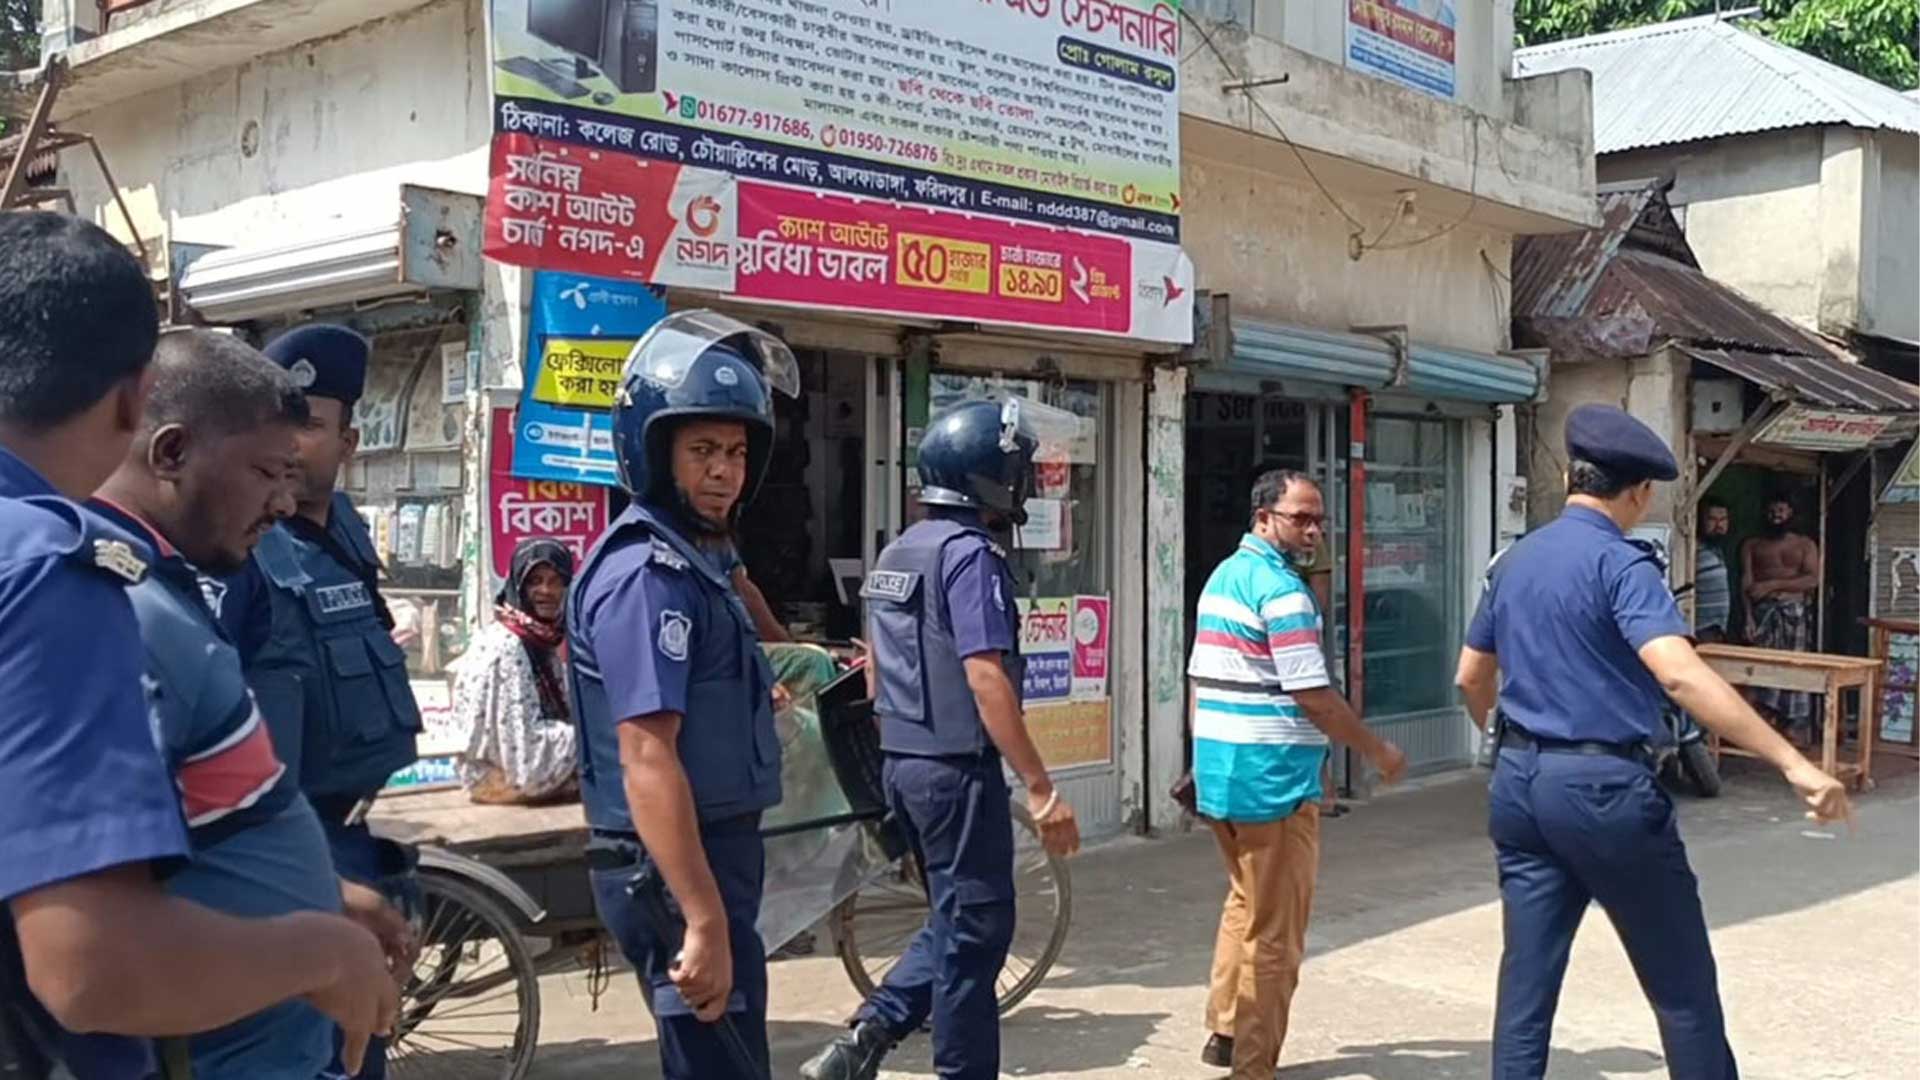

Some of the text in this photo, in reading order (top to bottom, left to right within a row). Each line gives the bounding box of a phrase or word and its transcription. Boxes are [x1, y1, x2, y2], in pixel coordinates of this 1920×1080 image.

[672, 8, 699, 26] করা
[705, 16, 725, 32] হয়
[1060, 0, 1175, 56] স্টেশনারি
[697, 98, 813, 141] 01677-917686,
[839, 126, 938, 165] 01950-726876
[576, 117, 635, 149] কলেজ
[641, 129, 684, 160] রোড,
[783, 155, 822, 183] মোড়,
[914, 172, 967, 205] ফরিদপুর
[981, 189, 1033, 212] E-mail:
[565, 194, 636, 227] আউট
[559, 225, 645, 260] নগদ-এ
[677, 237, 729, 266] নগদ
[777, 215, 889, 250] ক্যাশ আউটে
[736, 230, 889, 285] সুবিধা ডাবল
[902, 240, 947, 284] ৫০
[1006, 268, 1059, 297] ১৪.৯০
[1070, 255, 1090, 304] ২
[558, 375, 594, 395] করা
[498, 492, 596, 533] বিকাশ
